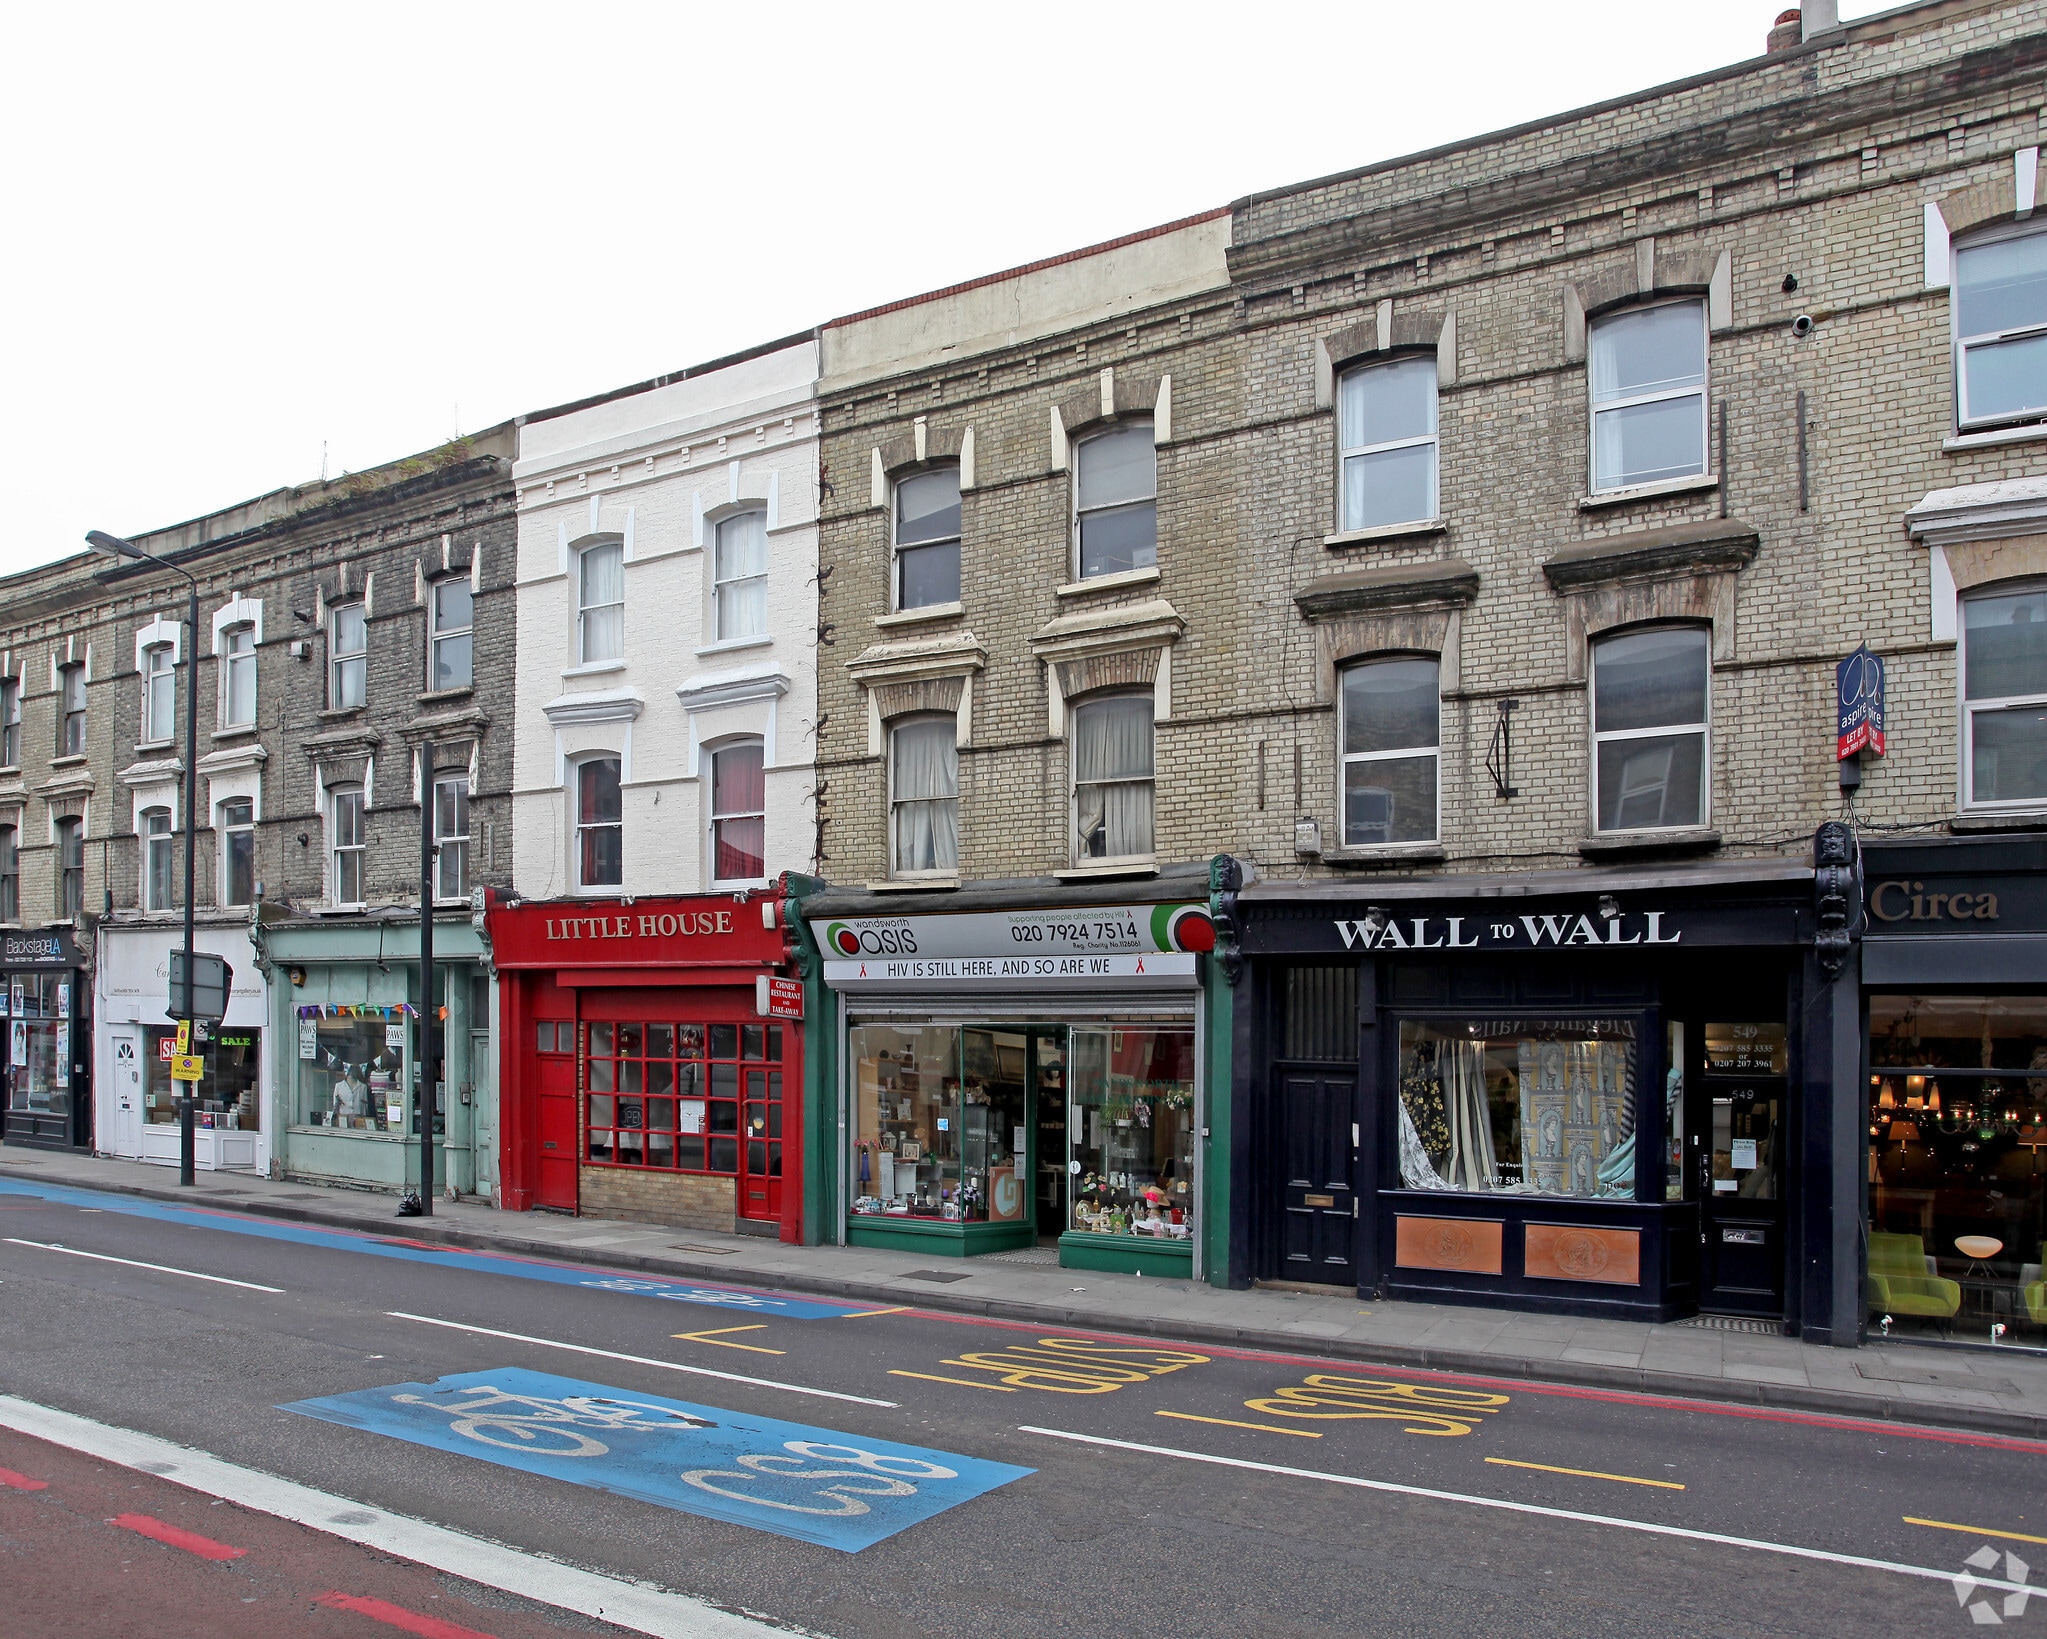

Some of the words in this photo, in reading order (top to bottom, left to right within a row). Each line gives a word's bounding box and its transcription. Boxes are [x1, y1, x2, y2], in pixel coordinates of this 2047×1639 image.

[1842, 702, 1866, 728] aspire
[1847, 729, 1856, 744] LET
[1858, 724, 1864, 737] BY
[1870, 880, 2000, 921] Circa
[854, 918, 910, 929] wandsworth
[1008, 914, 1045, 924] Supporting
[1046, 914, 1072, 922] people
[1104, 912, 1114, 920] by
[545, 916, 632, 940] LITTLE
[637, 911, 734, 937] HOUSE
[1334, 917, 1479, 949] WALL
[1519, 911, 1682, 946] WALL
[1011, 925, 1042, 942] 020
[1047, 923, 1089, 941] 7924
[1093, 922, 1137, 939] 7514
[1073, 942, 1085, 950] Reg.
[1087, 941, 1108, 949] Charity
[887, 962, 908, 977] HIV
[913, 962, 923, 977] IS
[928, 962, 957, 977] STILL
[962, 961, 997, 976] HERE,
[1001, 960, 1030, 975] AND
[1034, 959, 1054, 974] SO
[1059, 959, 1084, 974] ARE
[1089, 958, 1109, 973] WE
[776, 981, 796, 990] CHINESE
[771, 989, 800, 999] RESTAURANT
[772, 1005, 799, 1015] TAKE-AWAY
[300, 1025, 316, 1034] PAWS
[386, 1030, 403, 1039] PAWS
[1733, 1026, 1758, 1038] 549
[221, 1037, 251, 1046] SALE
[1732, 1089, 1754, 1099] 549
[621, 1111, 642, 1124] OPEN
[1505, 1176, 1520, 1184] 585
[939, 1338, 1211, 1394] STOP
[1243, 1374, 1510, 1437] BUS
[681, 1441, 959, 1517] CS8
